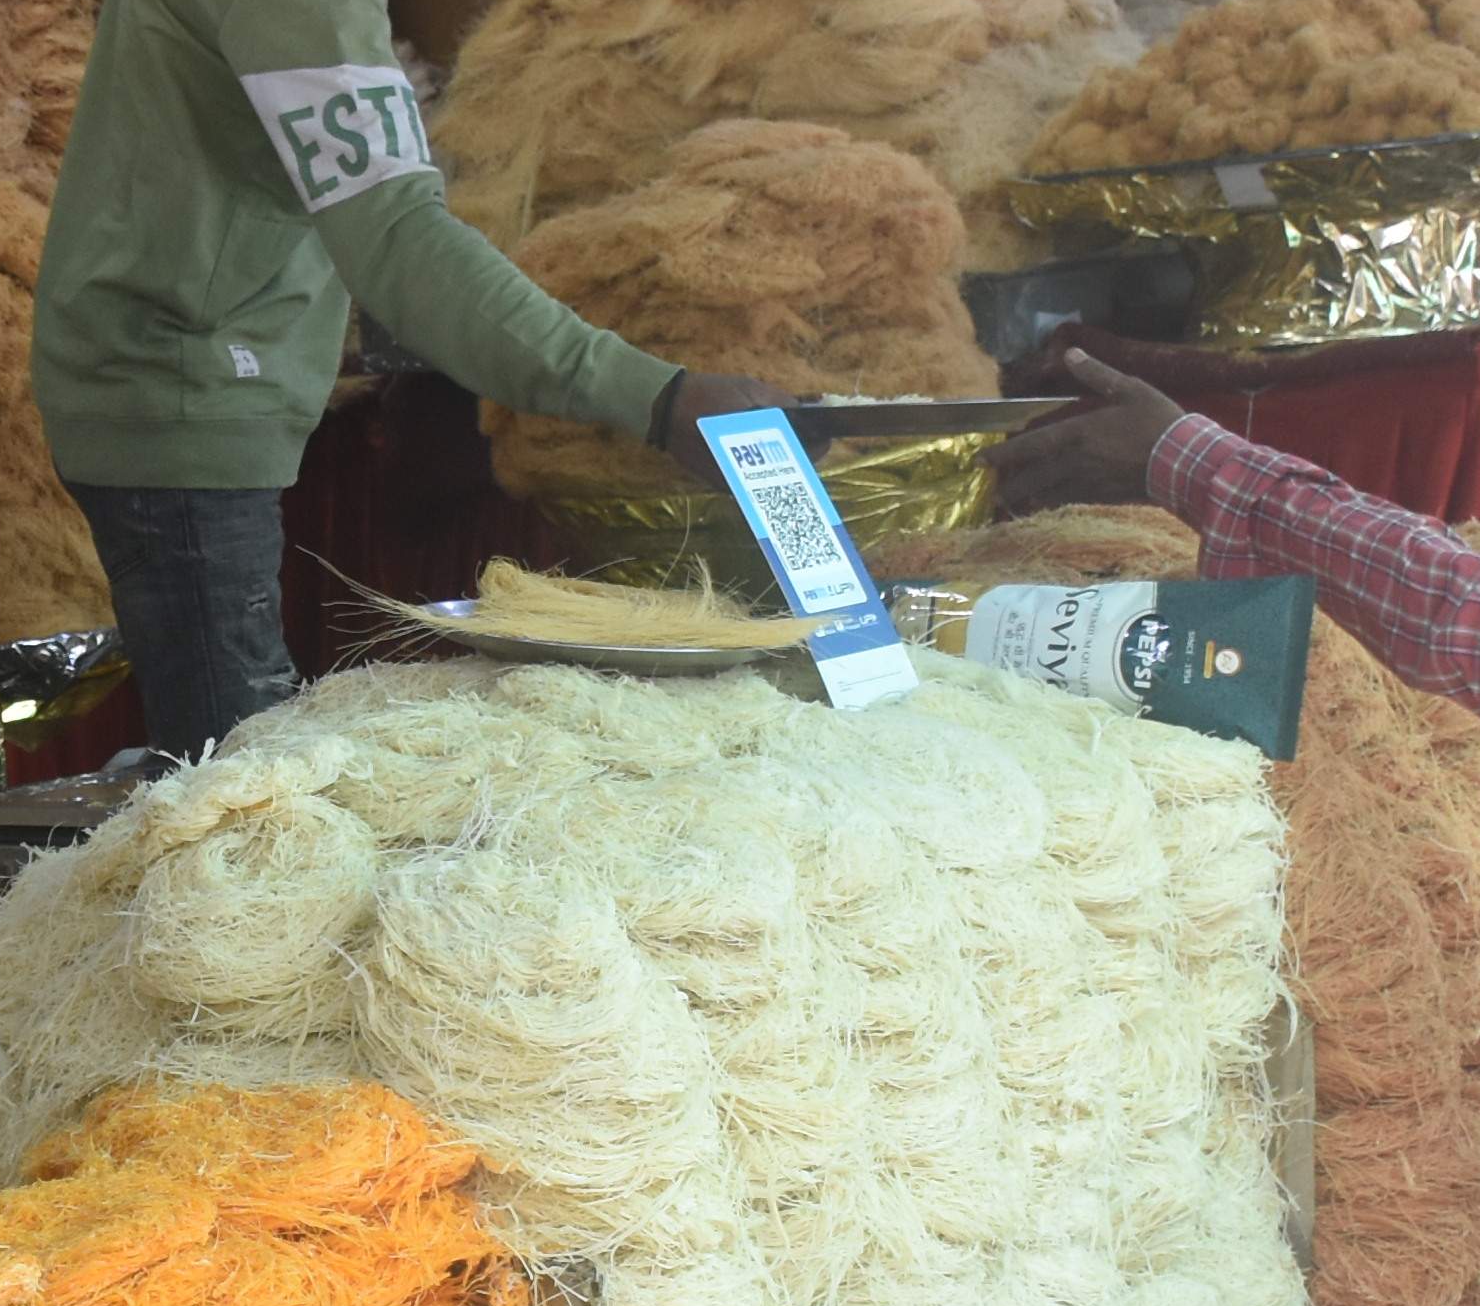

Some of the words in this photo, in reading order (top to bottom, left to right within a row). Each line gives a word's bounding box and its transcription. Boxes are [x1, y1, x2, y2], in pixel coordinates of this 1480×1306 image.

[729, 438, 791, 469] paytm
[743, 468, 777, 481] Accepted
[778, 466, 797, 476] Here
[1037, 589, 1101, 692] Seviya
[1132, 619, 1159, 690] PEPSI
